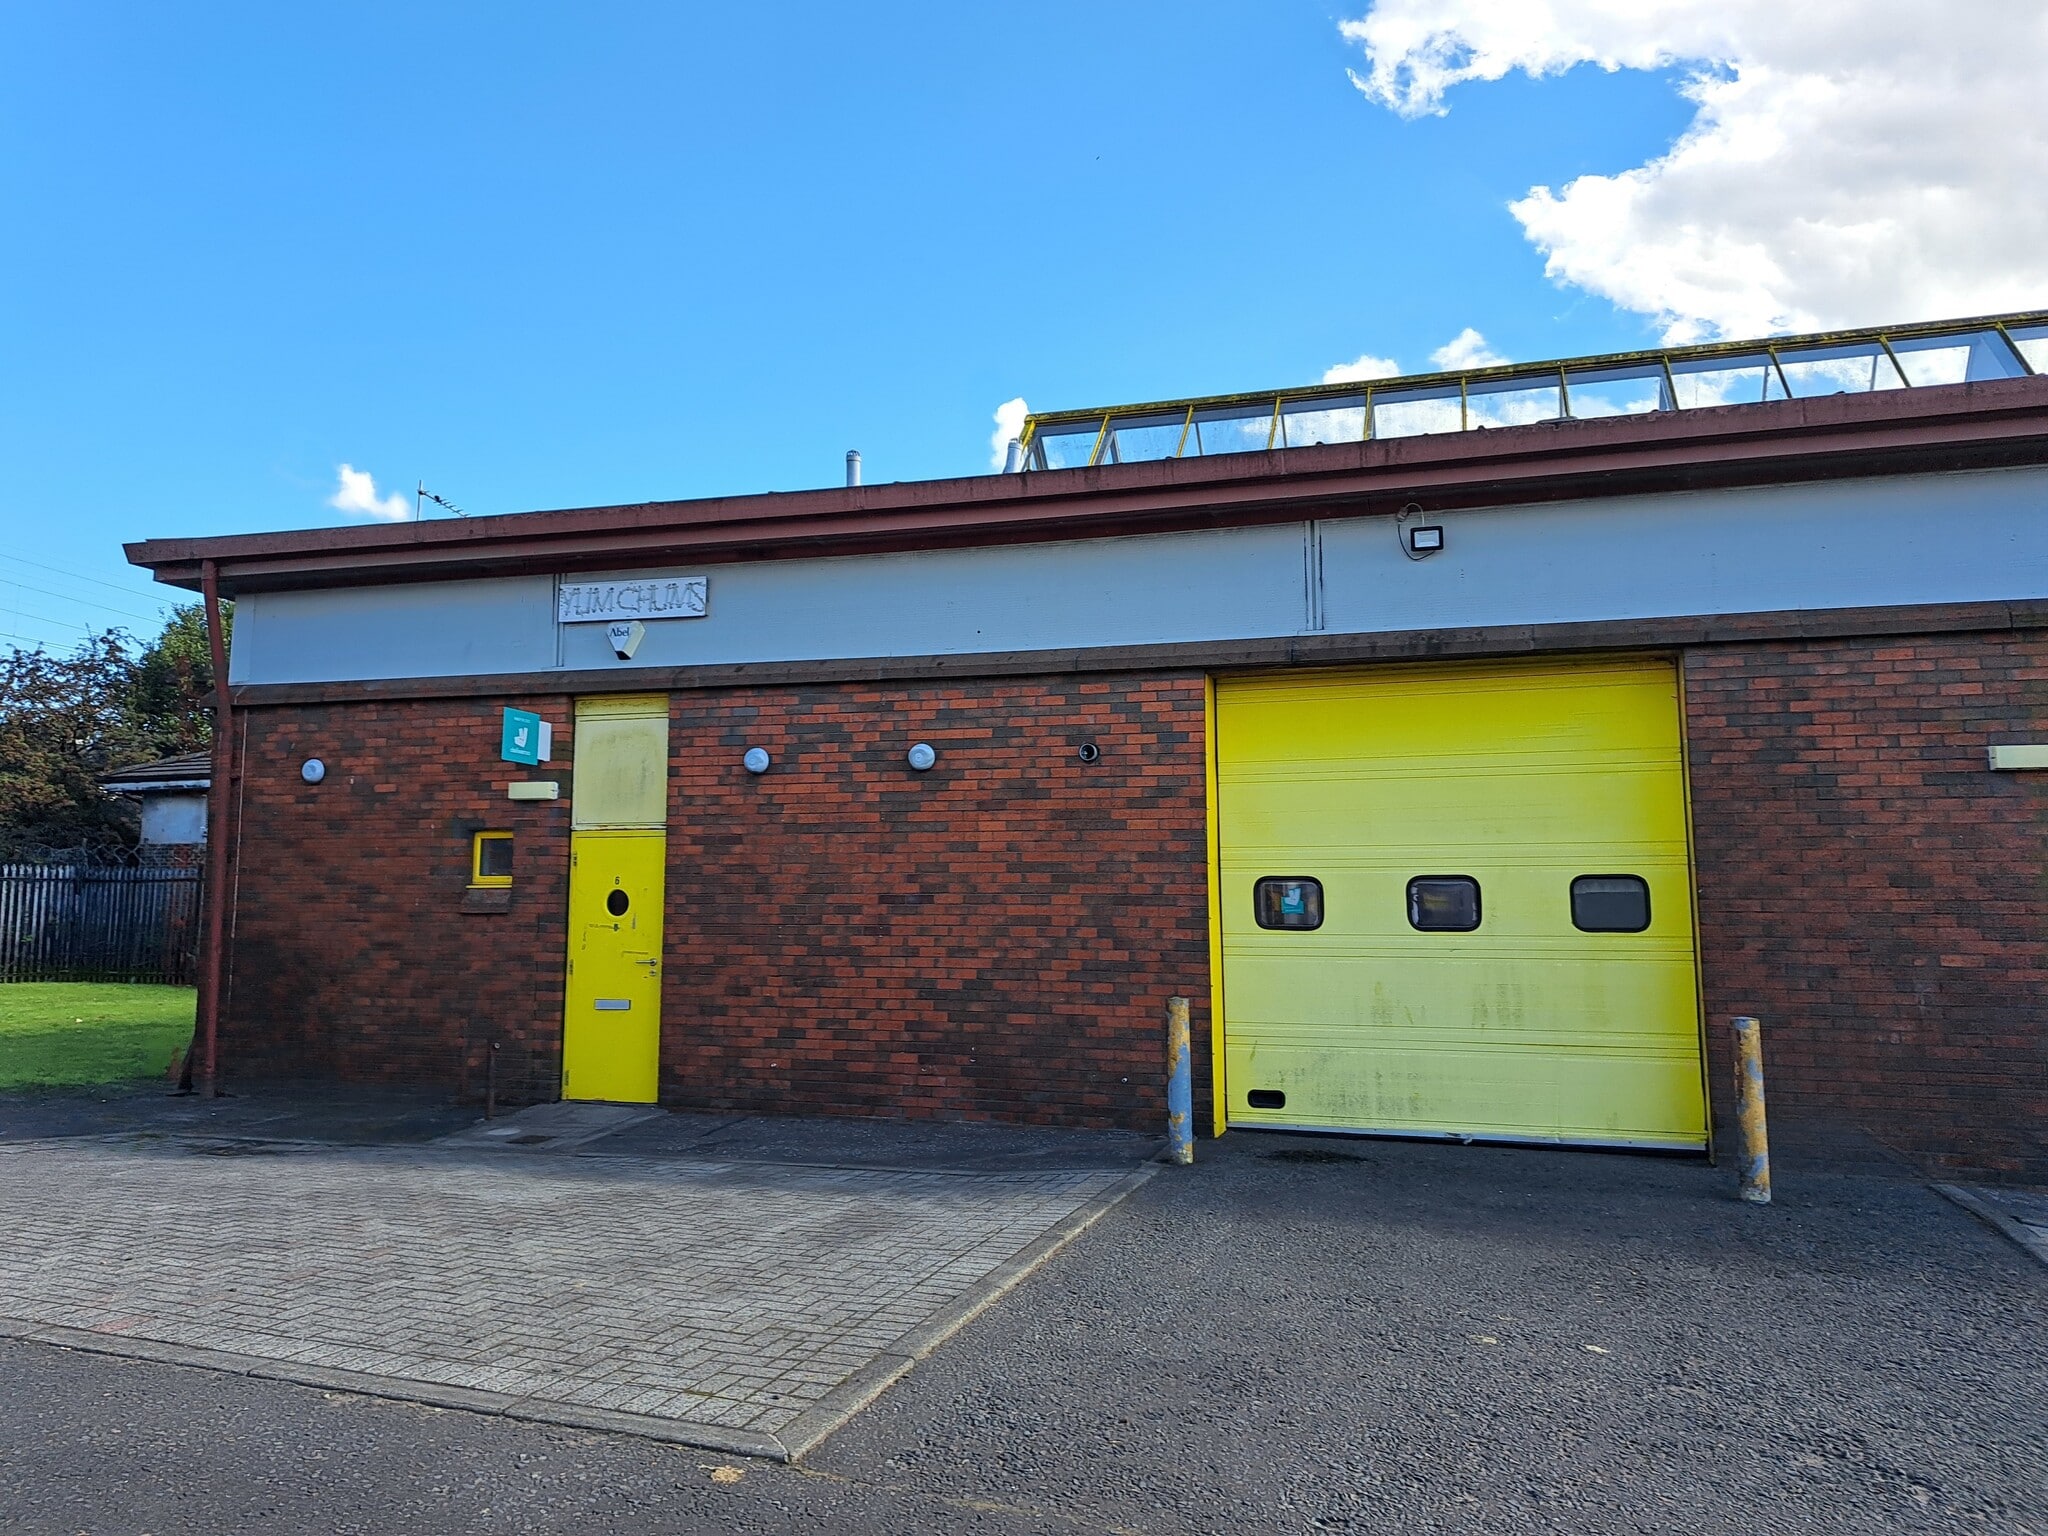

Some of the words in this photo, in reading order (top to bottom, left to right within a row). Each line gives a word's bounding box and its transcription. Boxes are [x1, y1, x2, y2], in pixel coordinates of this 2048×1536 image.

[560, 582, 706, 616] YUMCHUMS
[609, 626, 630, 637] Abel
[614, 876, 620, 885] 6
